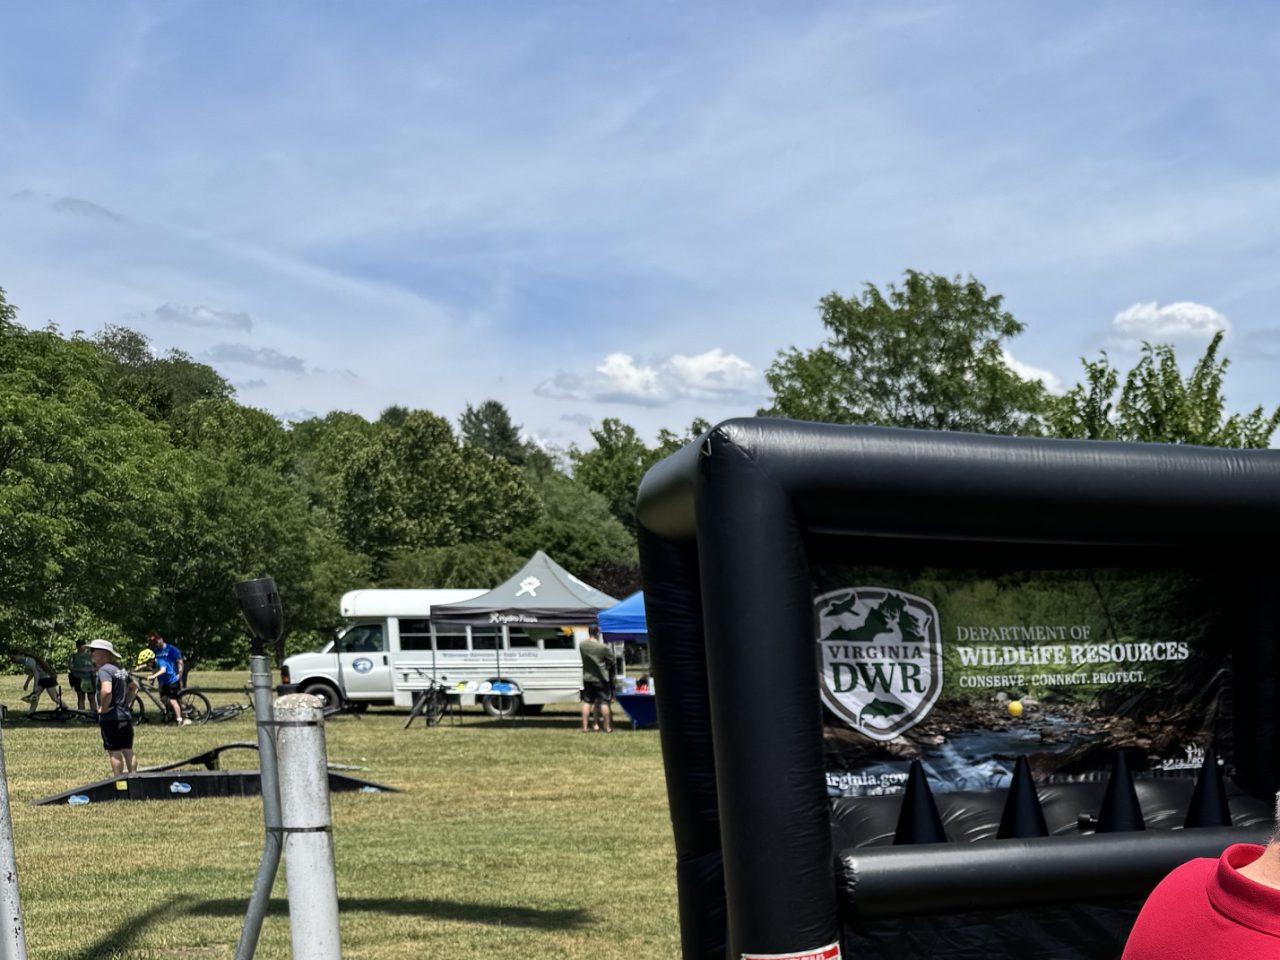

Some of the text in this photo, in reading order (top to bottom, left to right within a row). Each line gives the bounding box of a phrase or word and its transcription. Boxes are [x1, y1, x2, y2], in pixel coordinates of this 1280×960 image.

[957, 625, 1091, 641] DEPARTMENT OF
[828, 646, 923, 659] VIRGINIA
[956, 642, 1189, 667] WILDLIFE RESOURCES
[830, 662, 926, 693] DWR
[960, 670, 1146, 688] CONSERVE. CONNECT. PROTECT.
